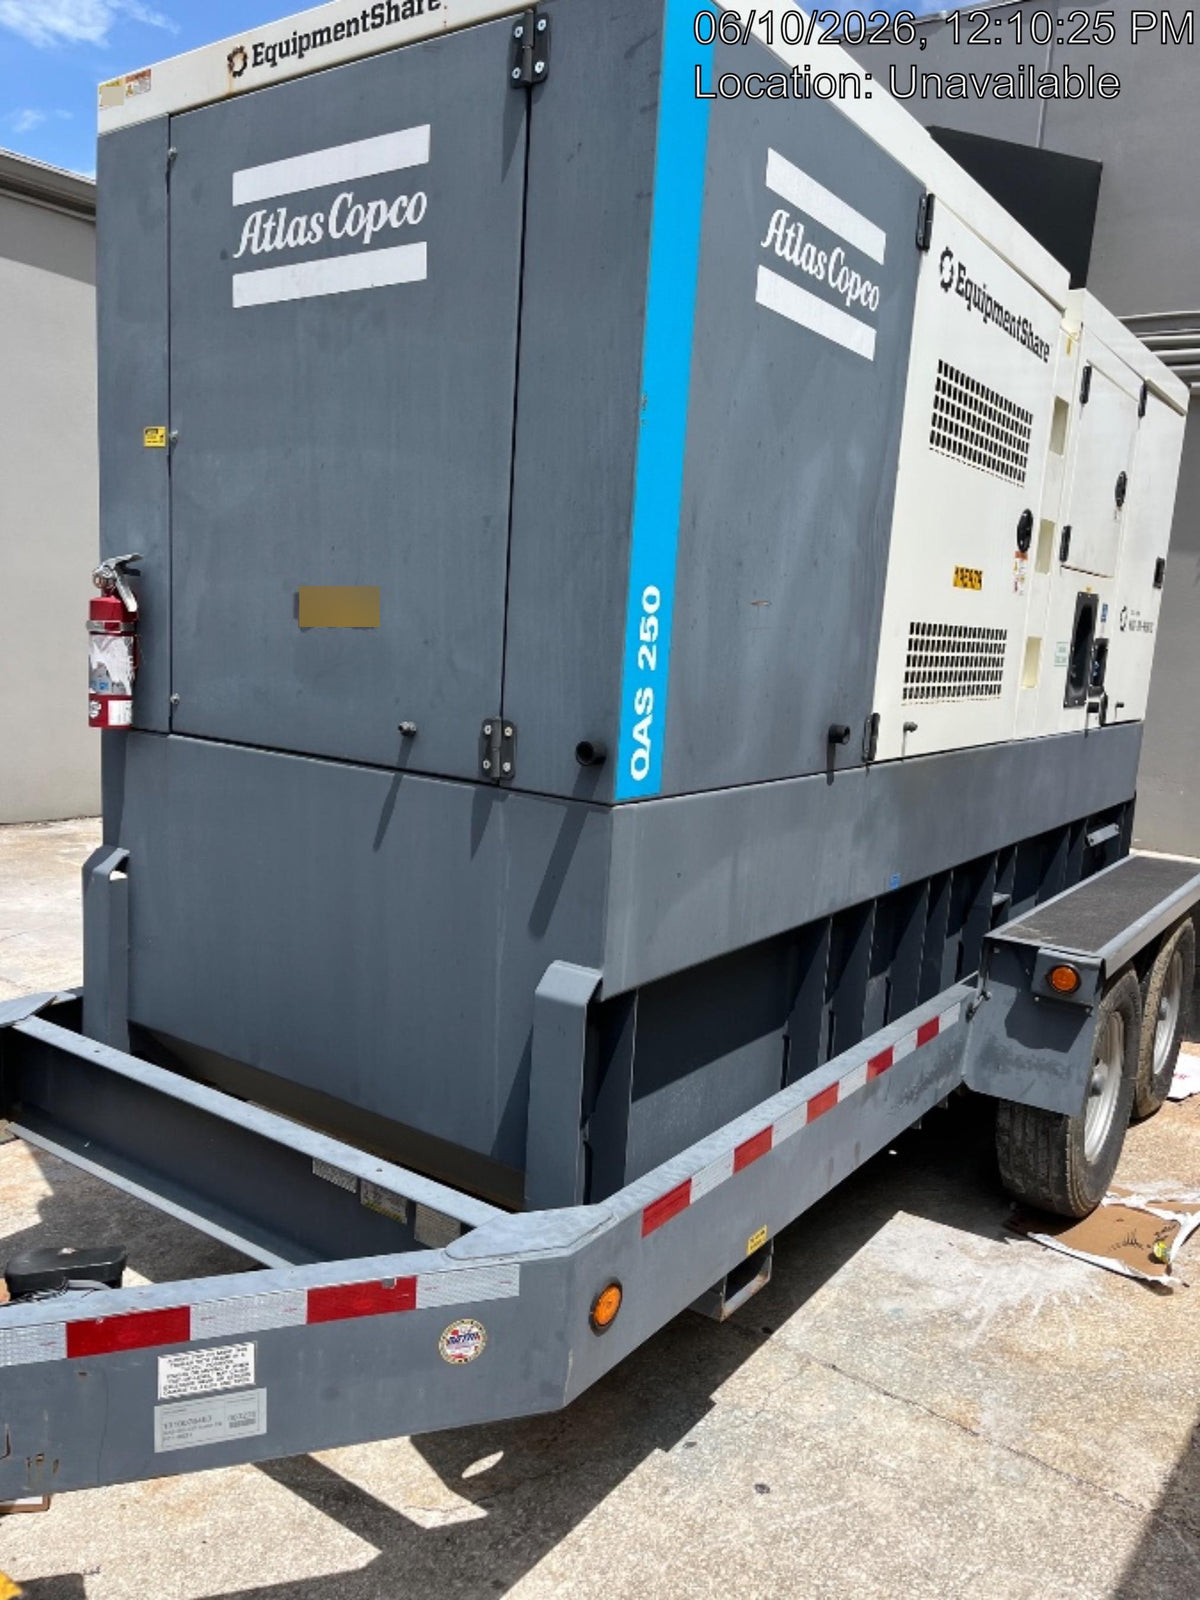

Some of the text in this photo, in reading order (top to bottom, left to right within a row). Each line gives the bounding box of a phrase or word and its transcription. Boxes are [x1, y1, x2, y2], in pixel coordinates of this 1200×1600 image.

[251, 0, 440, 68] EquipmentShare
[954, 260, 1051, 363] EquipmentShare
[637, 584, 662, 672] 250
